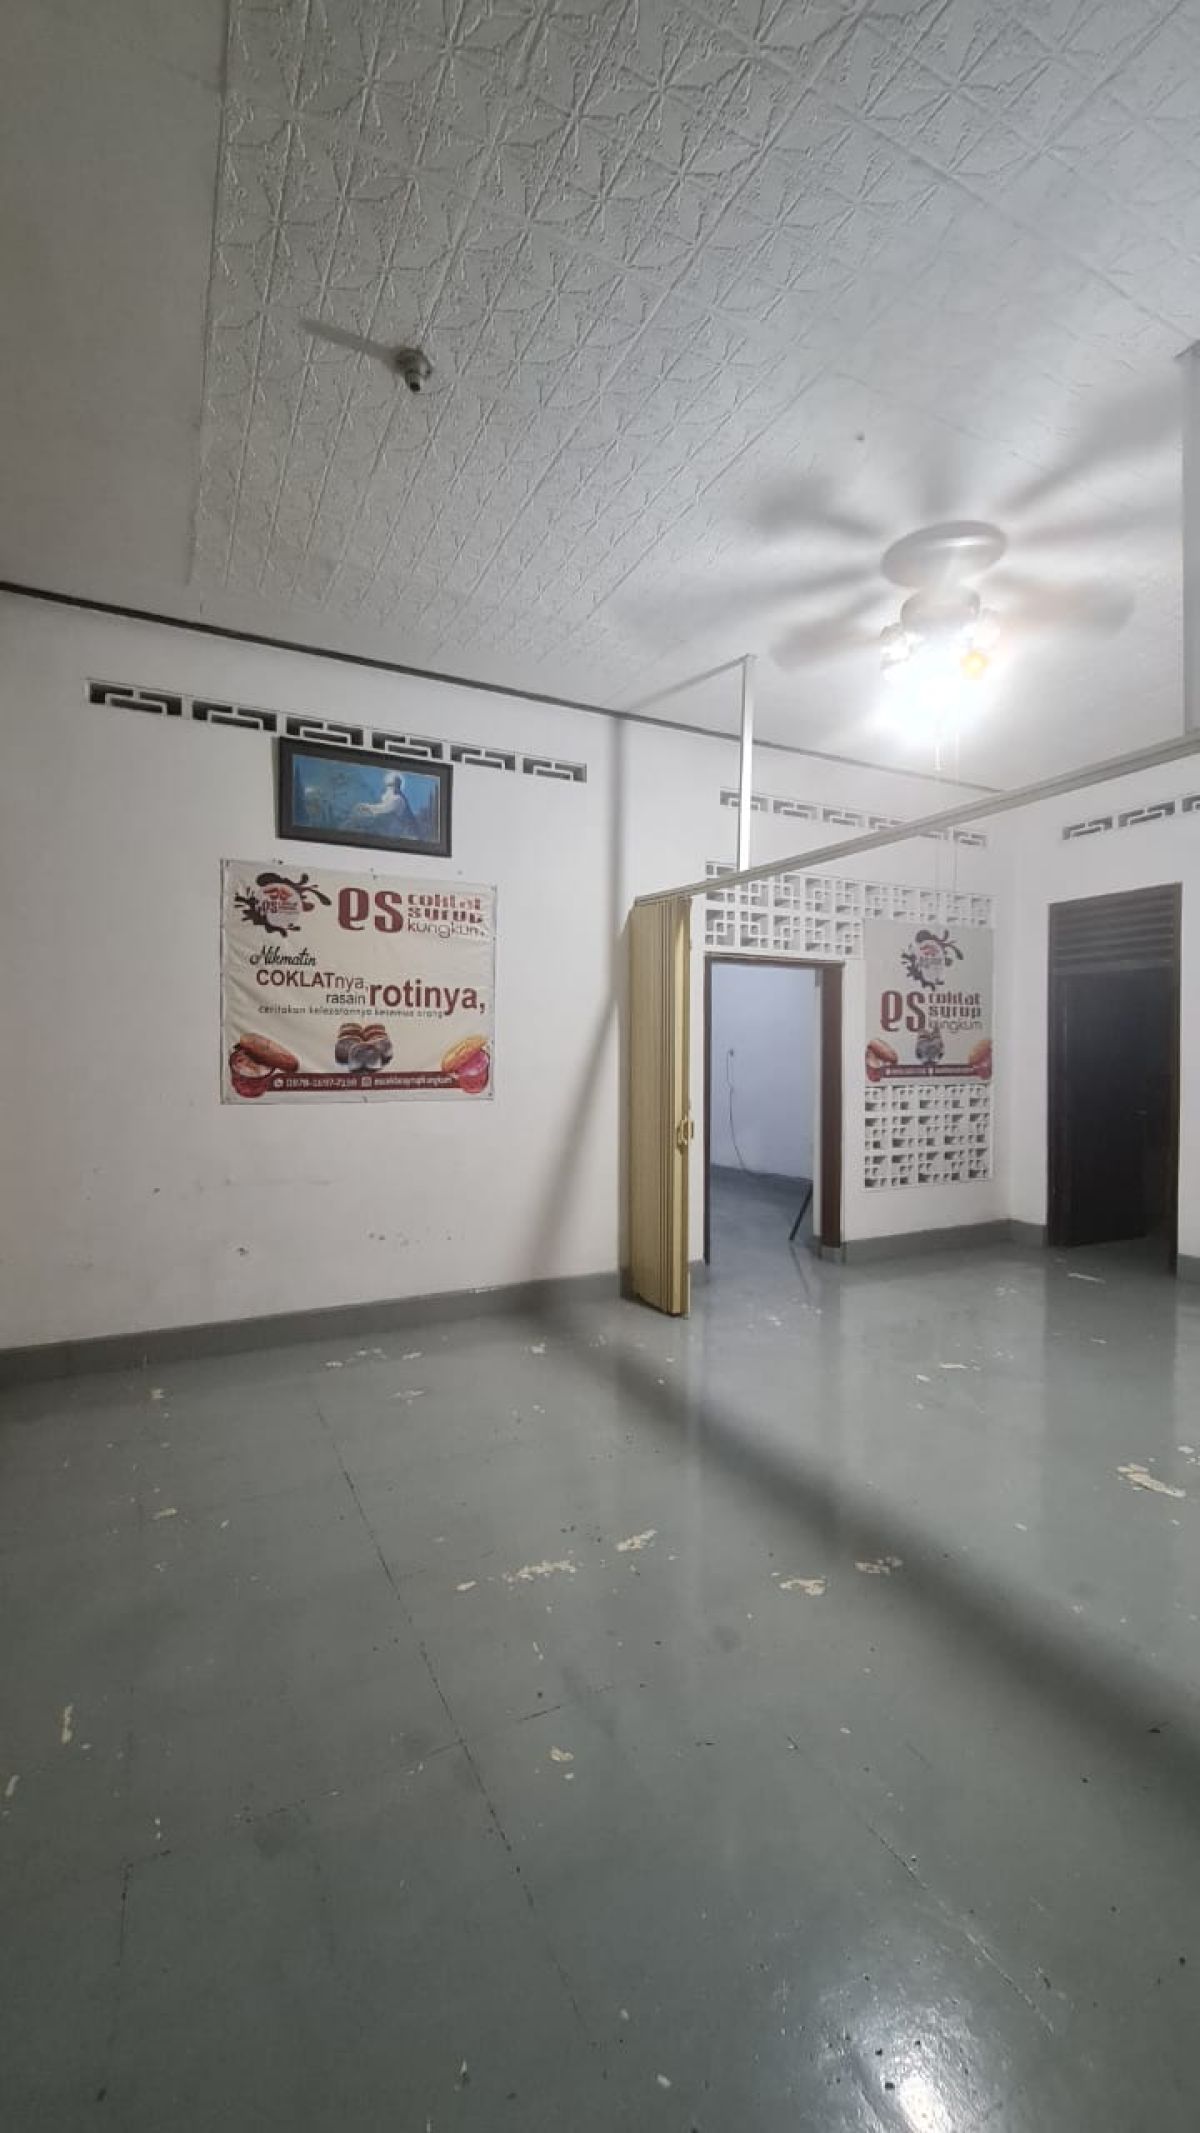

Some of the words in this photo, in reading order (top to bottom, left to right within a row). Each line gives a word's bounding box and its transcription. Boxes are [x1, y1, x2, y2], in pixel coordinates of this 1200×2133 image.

[338, 887, 403, 933] es
[249, 945, 316, 966] Nikmatin
[326, 993, 366, 1005] rasain
[369, 979, 486, 1016] rotinya,
[880, 990, 926, 1032] es
